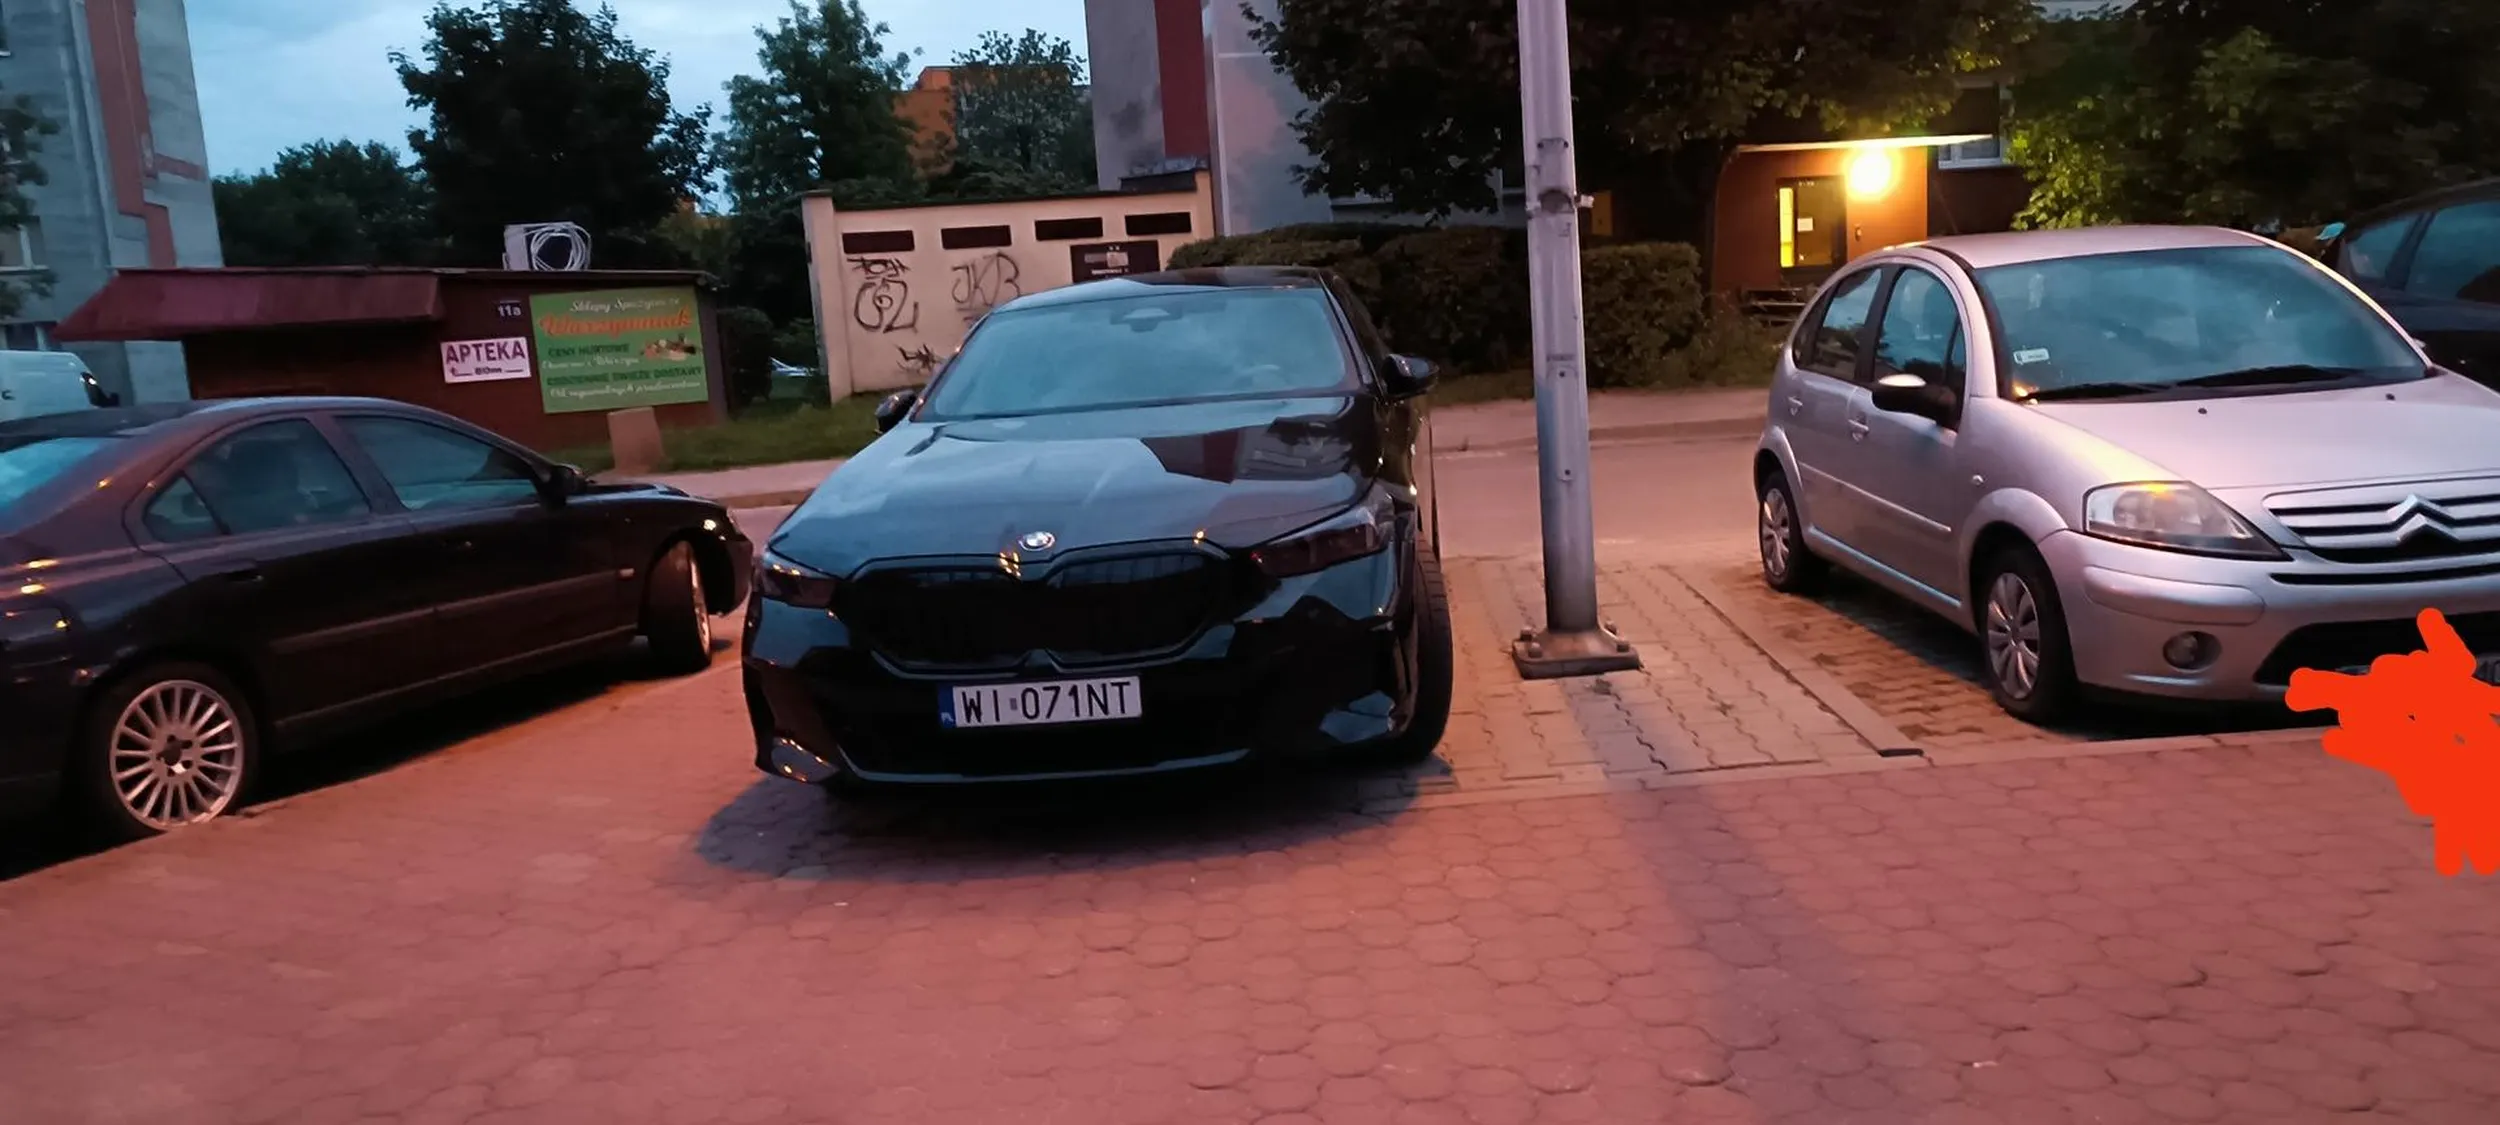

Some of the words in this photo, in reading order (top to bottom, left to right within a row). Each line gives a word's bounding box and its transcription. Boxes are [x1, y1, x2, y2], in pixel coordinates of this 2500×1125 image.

[446, 340, 526, 364] APTEKA
[961, 689, 1000, 724] WI
[1020, 681, 1131, 720] 071NT
